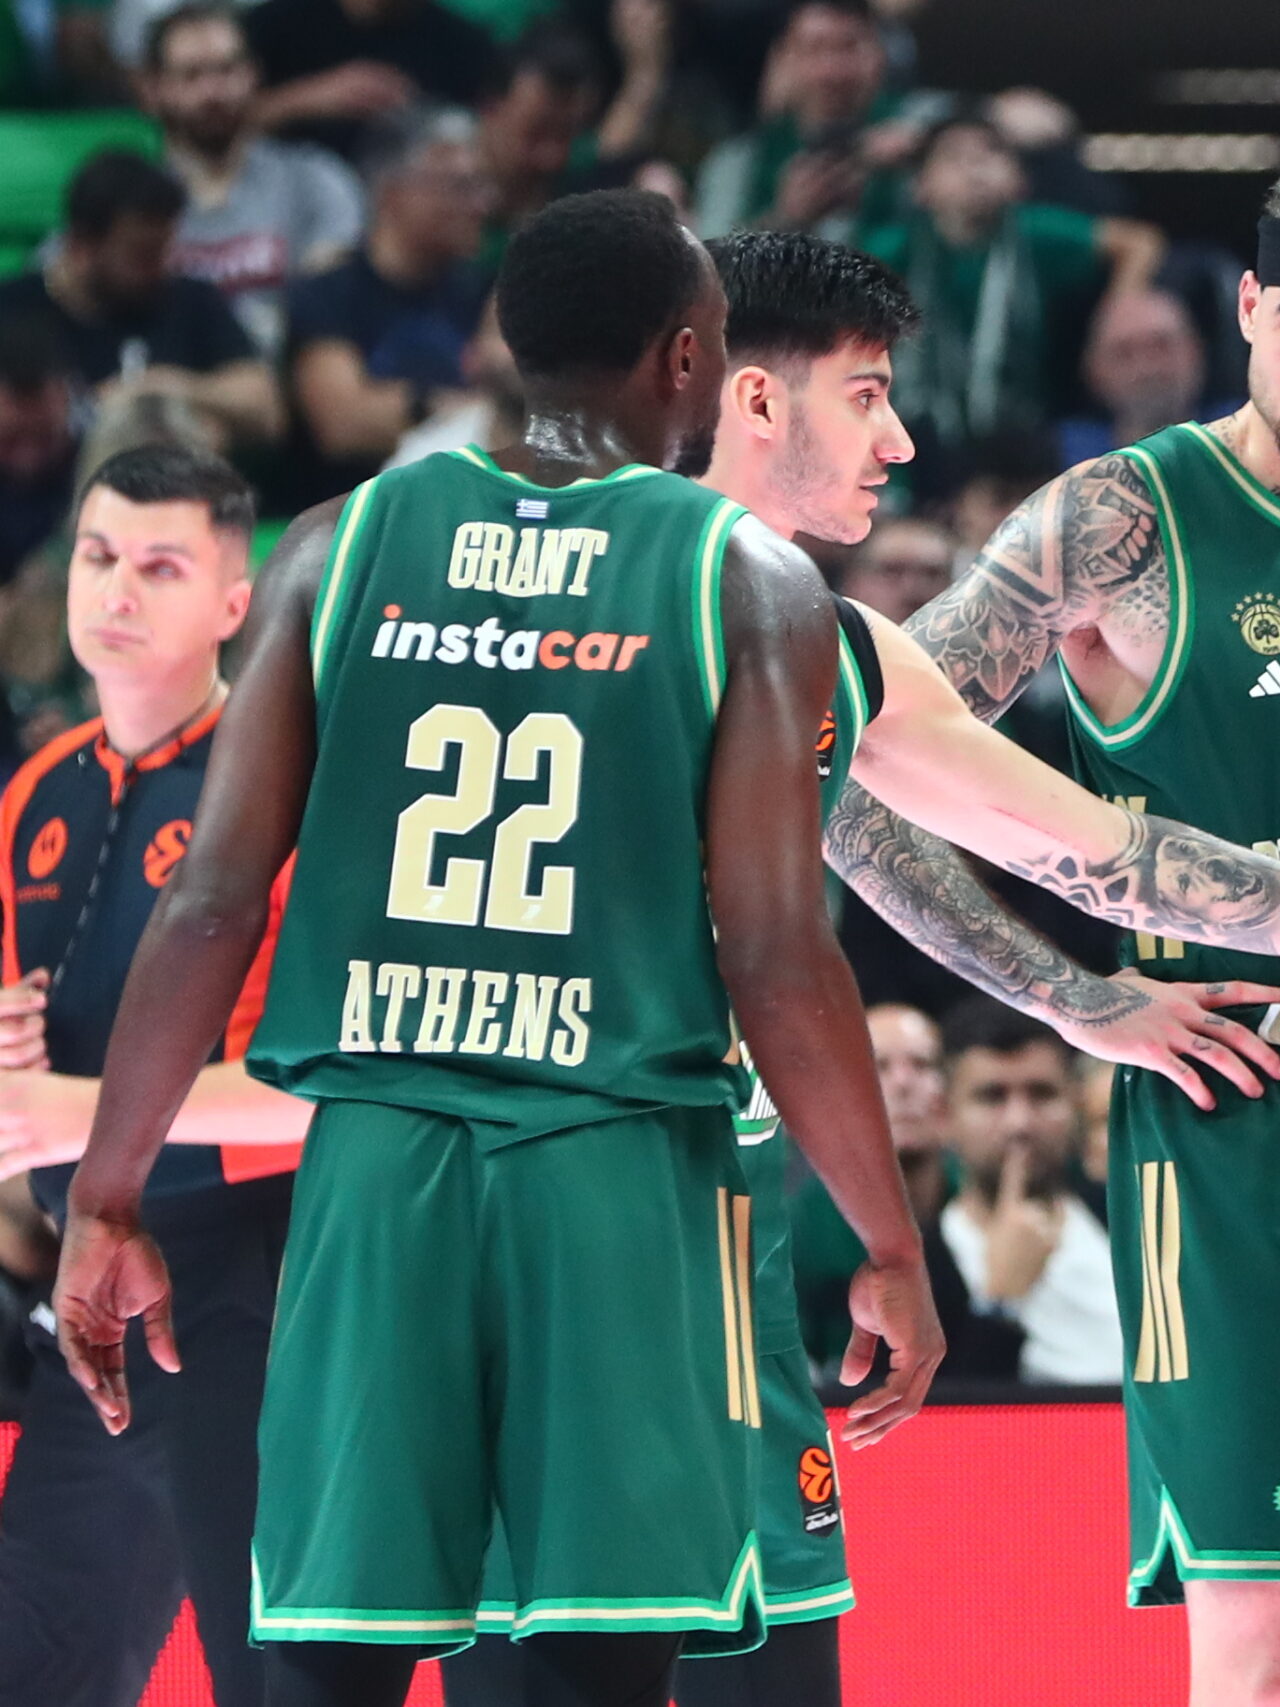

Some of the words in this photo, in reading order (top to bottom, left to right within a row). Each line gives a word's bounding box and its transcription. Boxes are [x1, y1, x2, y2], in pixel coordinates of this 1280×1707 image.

[447, 521, 609, 598] GRANT
[370, 604, 650, 672] instacar
[386, 702, 584, 935] 22
[338, 960, 592, 1067] ATHENS
